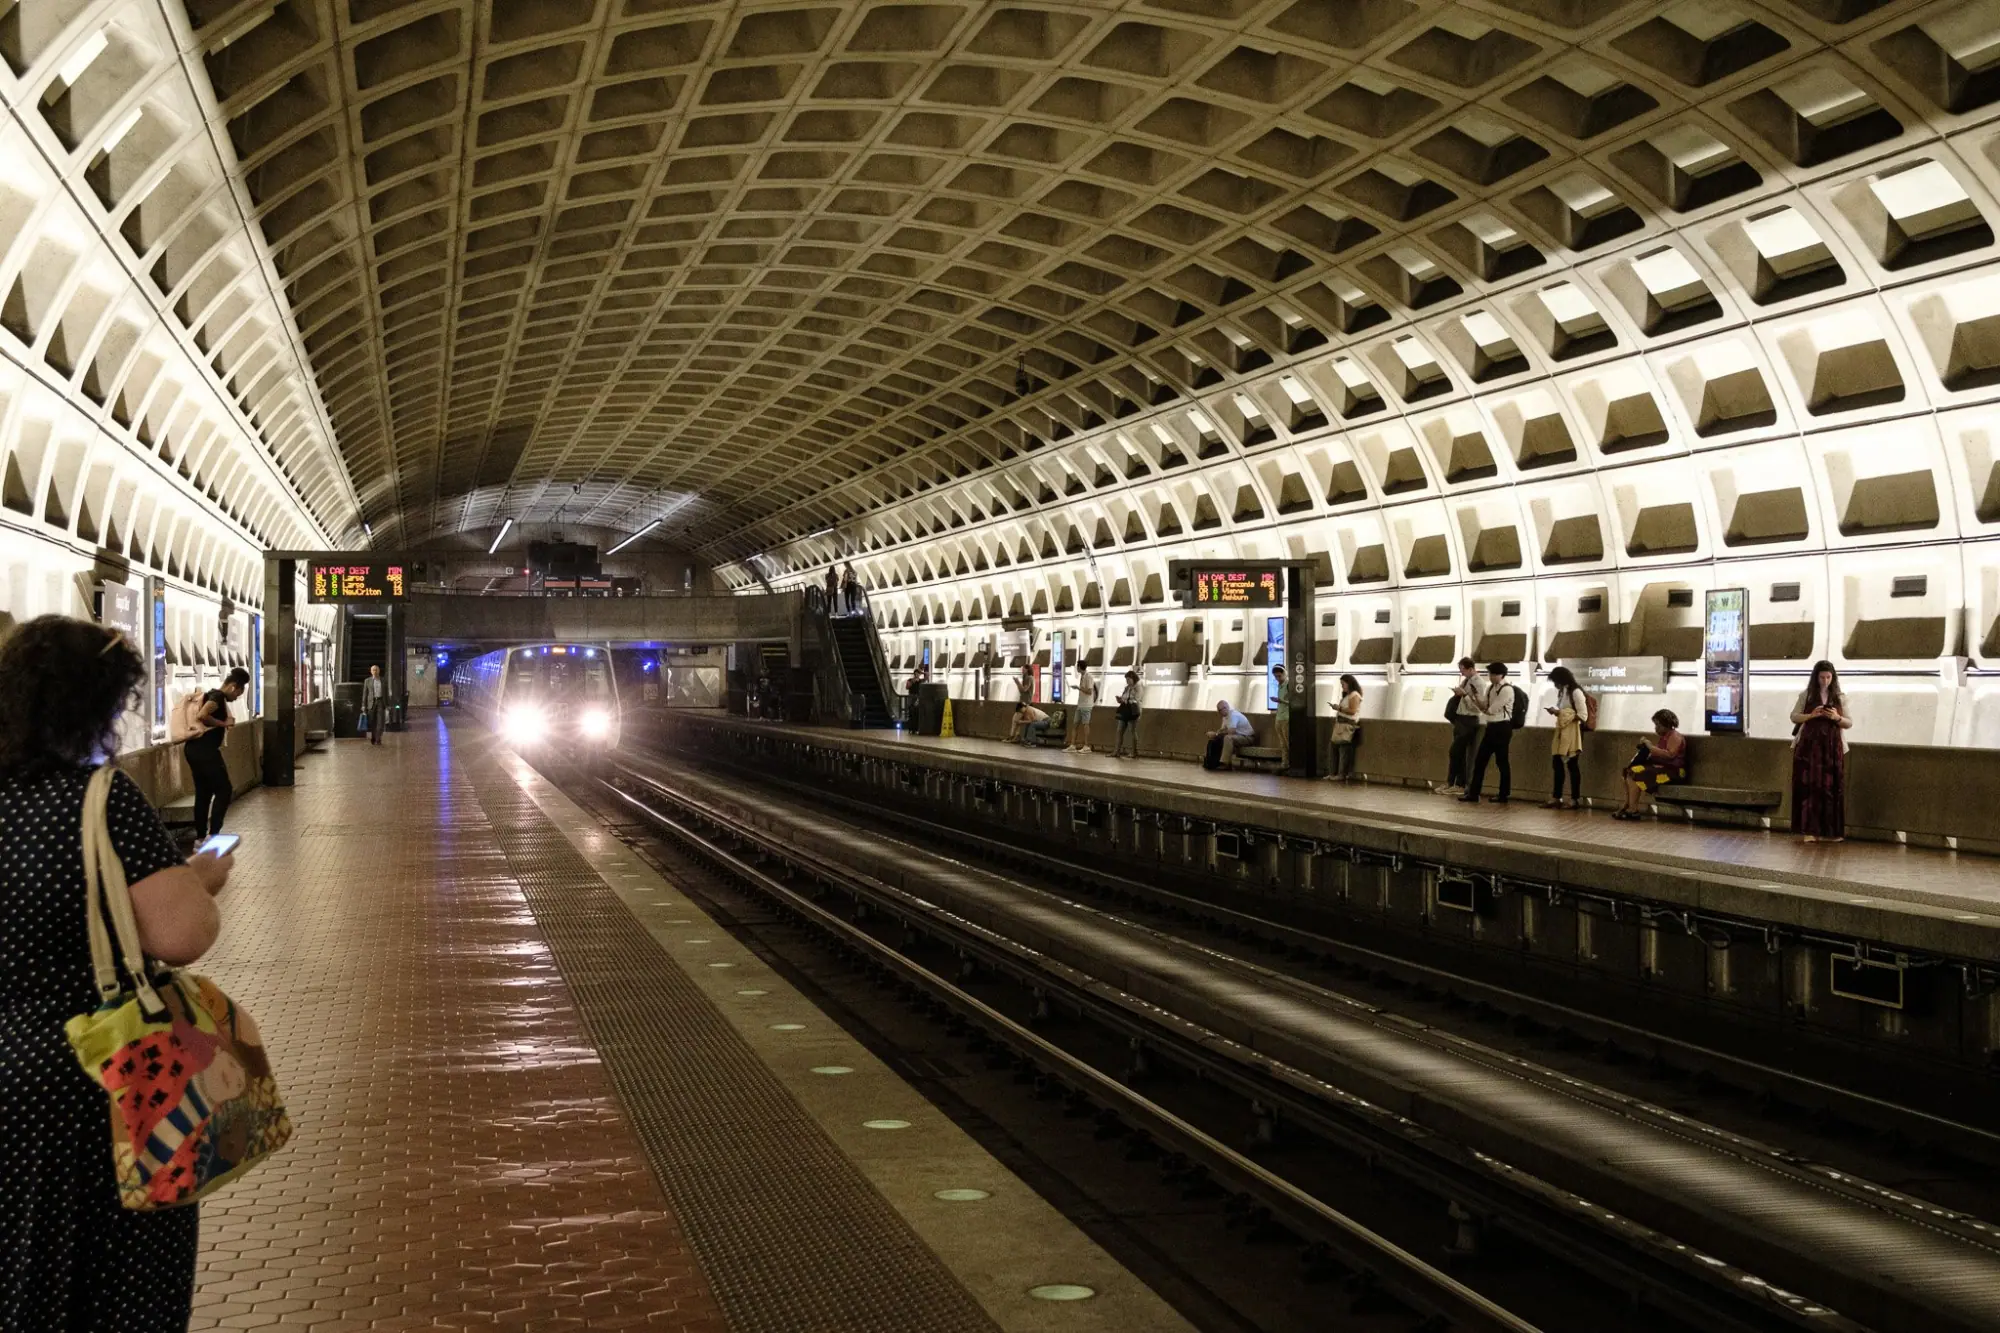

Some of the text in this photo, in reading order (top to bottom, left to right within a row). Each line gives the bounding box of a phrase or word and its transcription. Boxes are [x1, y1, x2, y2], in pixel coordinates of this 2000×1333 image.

[315, 567, 403, 575] LN CAR DEST MIN
[1222, 580, 1256, 588] Franconia
[315, 588, 327, 596] OR
[331, 588, 338, 596] 8
[1222, 593, 1249, 601] Ashburn
